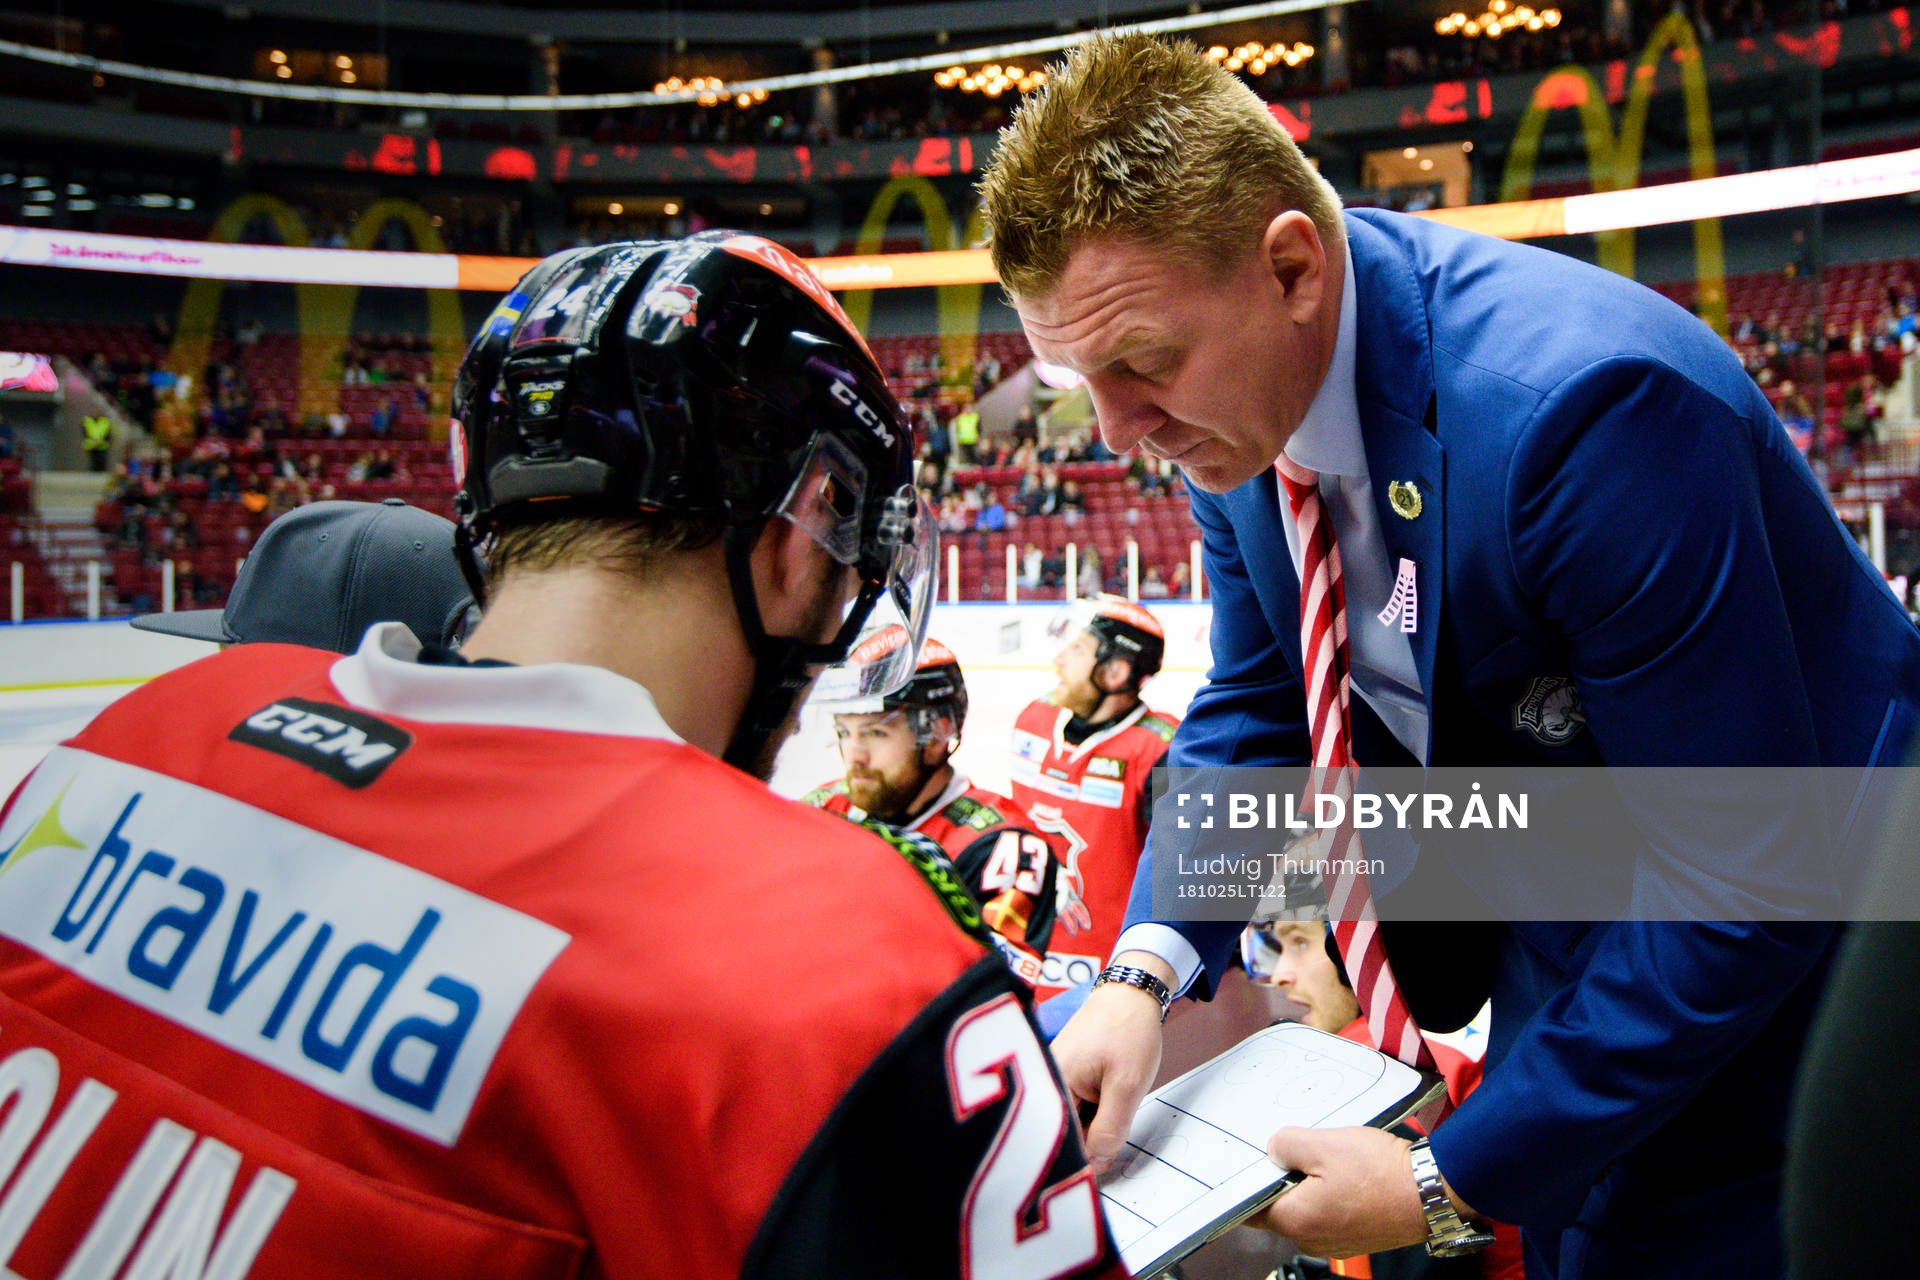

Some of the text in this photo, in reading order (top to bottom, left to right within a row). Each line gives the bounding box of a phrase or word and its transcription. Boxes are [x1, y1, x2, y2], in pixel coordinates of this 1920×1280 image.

[830, 377, 896, 449] CCM
[1398, 493, 1414, 507] 21
[246, 703, 396, 770] CCM
[981, 830, 1048, 896] 43
[51, 791, 481, 1113] bravida
[945, 991, 1104, 1280] 2
